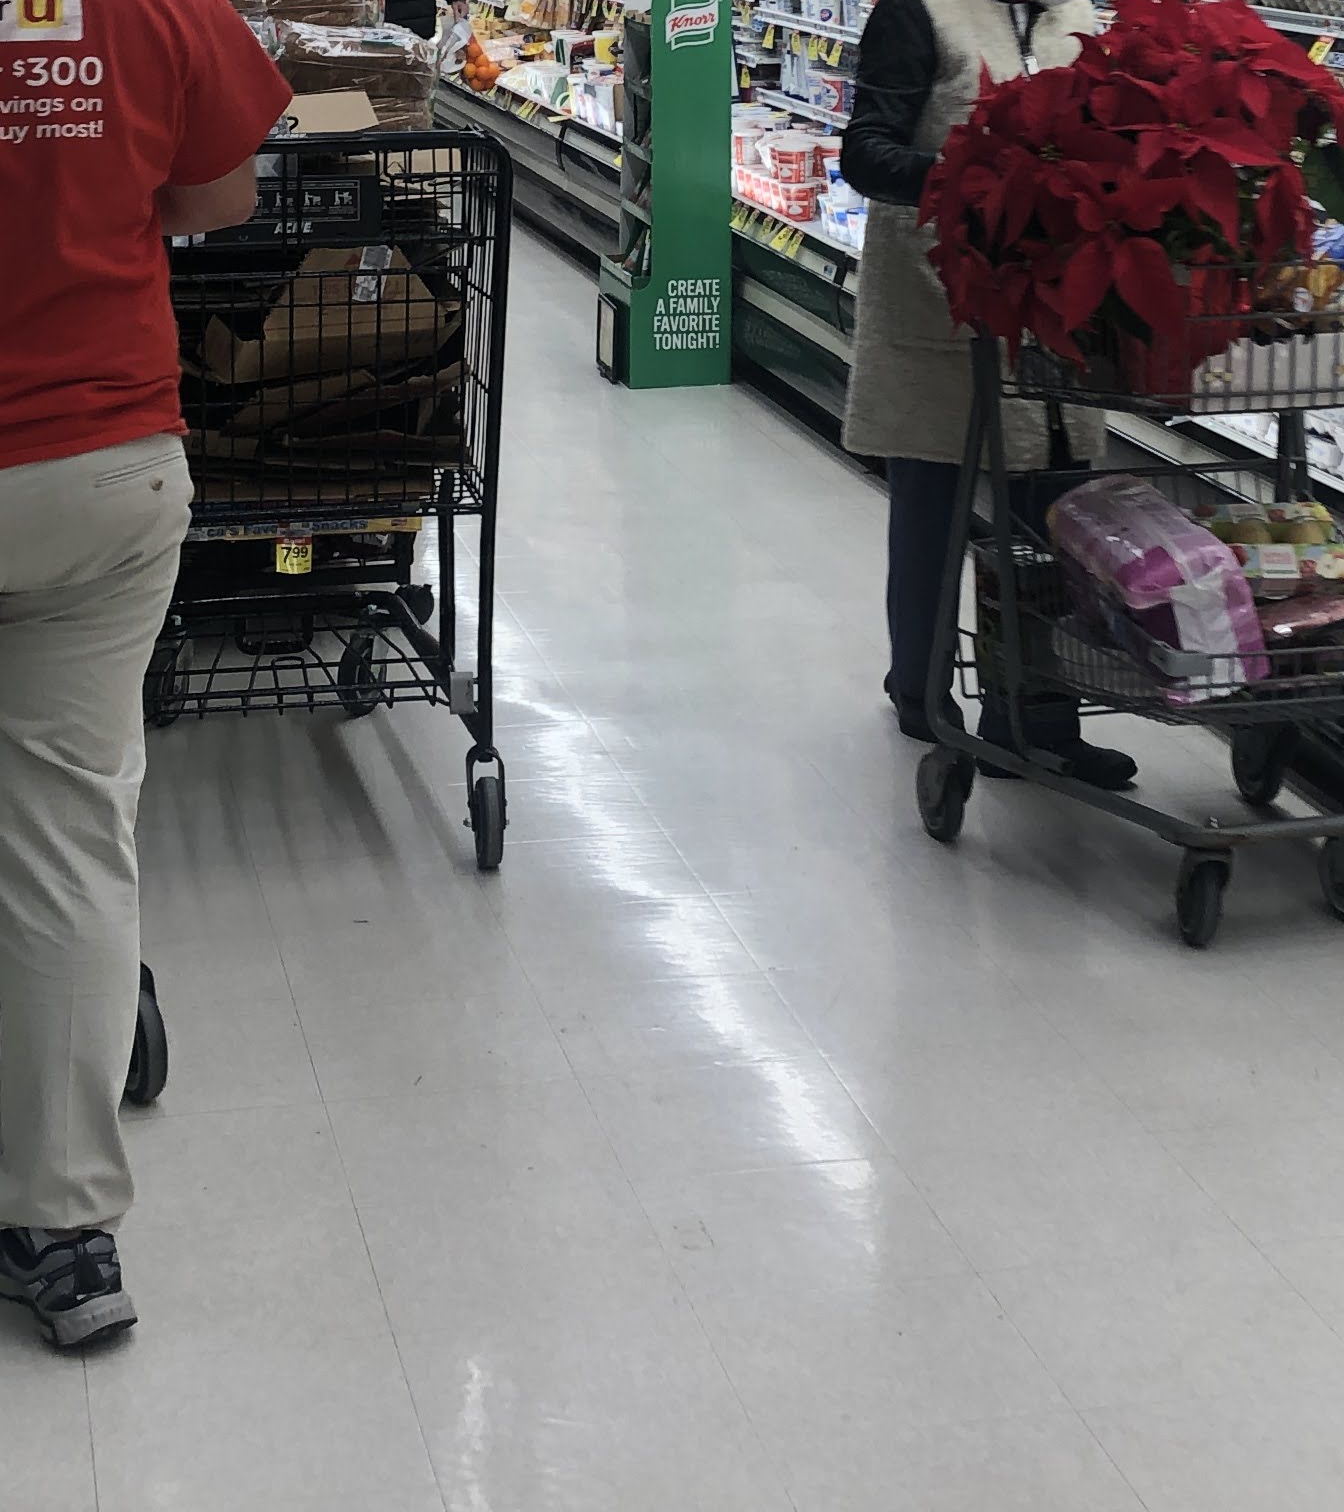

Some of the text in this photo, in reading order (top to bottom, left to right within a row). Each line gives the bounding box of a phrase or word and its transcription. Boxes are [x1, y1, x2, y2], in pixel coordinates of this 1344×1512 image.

[668, 11, 716, 33] Knorr
[12, 56, 104, 87] $300
[70, 97, 103, 113] on
[35, 120, 104, 139] most!
[667, 278, 721, 297] CREATE
[656, 296, 721, 314] A FAMILY
[653, 314, 721, 332] FAVORITE
[654, 332, 721, 350] TONIGHT!
